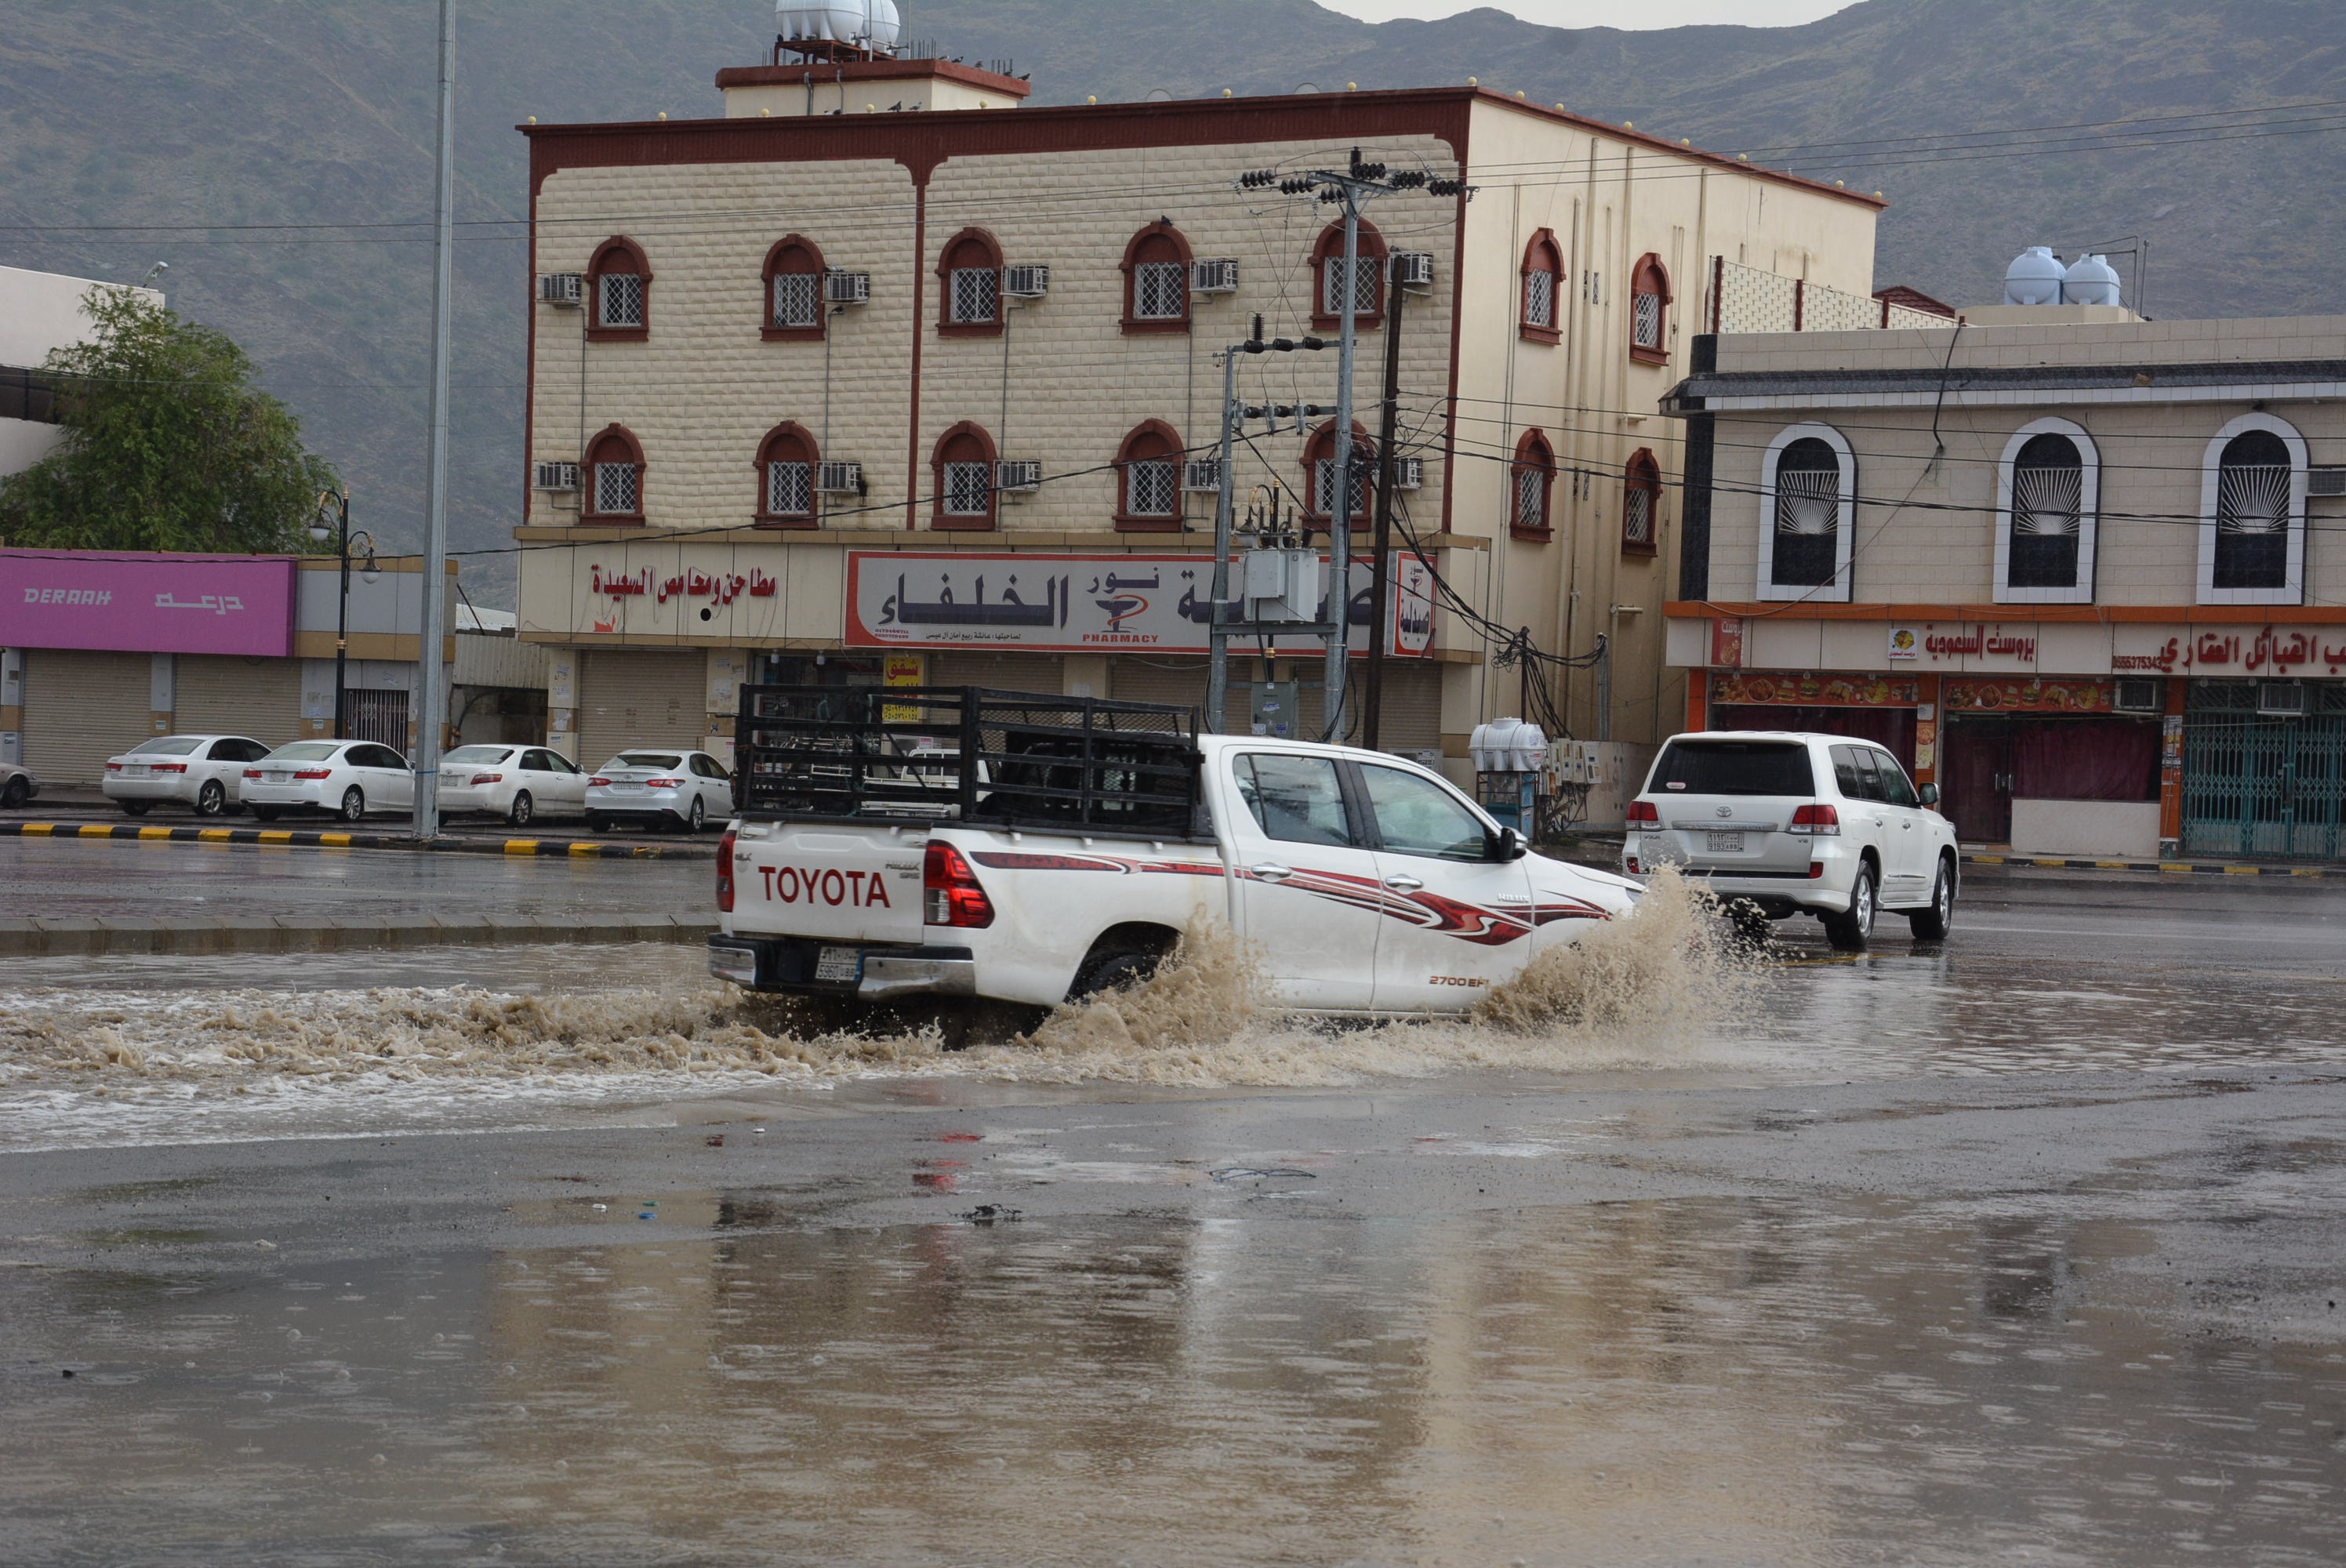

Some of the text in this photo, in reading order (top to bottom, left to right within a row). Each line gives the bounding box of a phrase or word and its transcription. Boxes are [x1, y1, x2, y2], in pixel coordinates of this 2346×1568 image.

[24, 587, 113, 606] DERAAH
[590, 564, 656, 602] السعيدة
[723, 566, 778, 605] مطاحن
[877, 572, 1070, 630] الخلفاء
[1082, 633, 1160, 644] PHARMACY
[1925, 623, 2035, 662] بروست السعودية
[2159, 631, 2240, 674] العقاري
[2245, 625, 2318, 675] القبائل
[886, 658, 919, 681] شقق
[1709, 842, 1724, 851] 9193
[758, 866, 892, 909] TOYOTA
